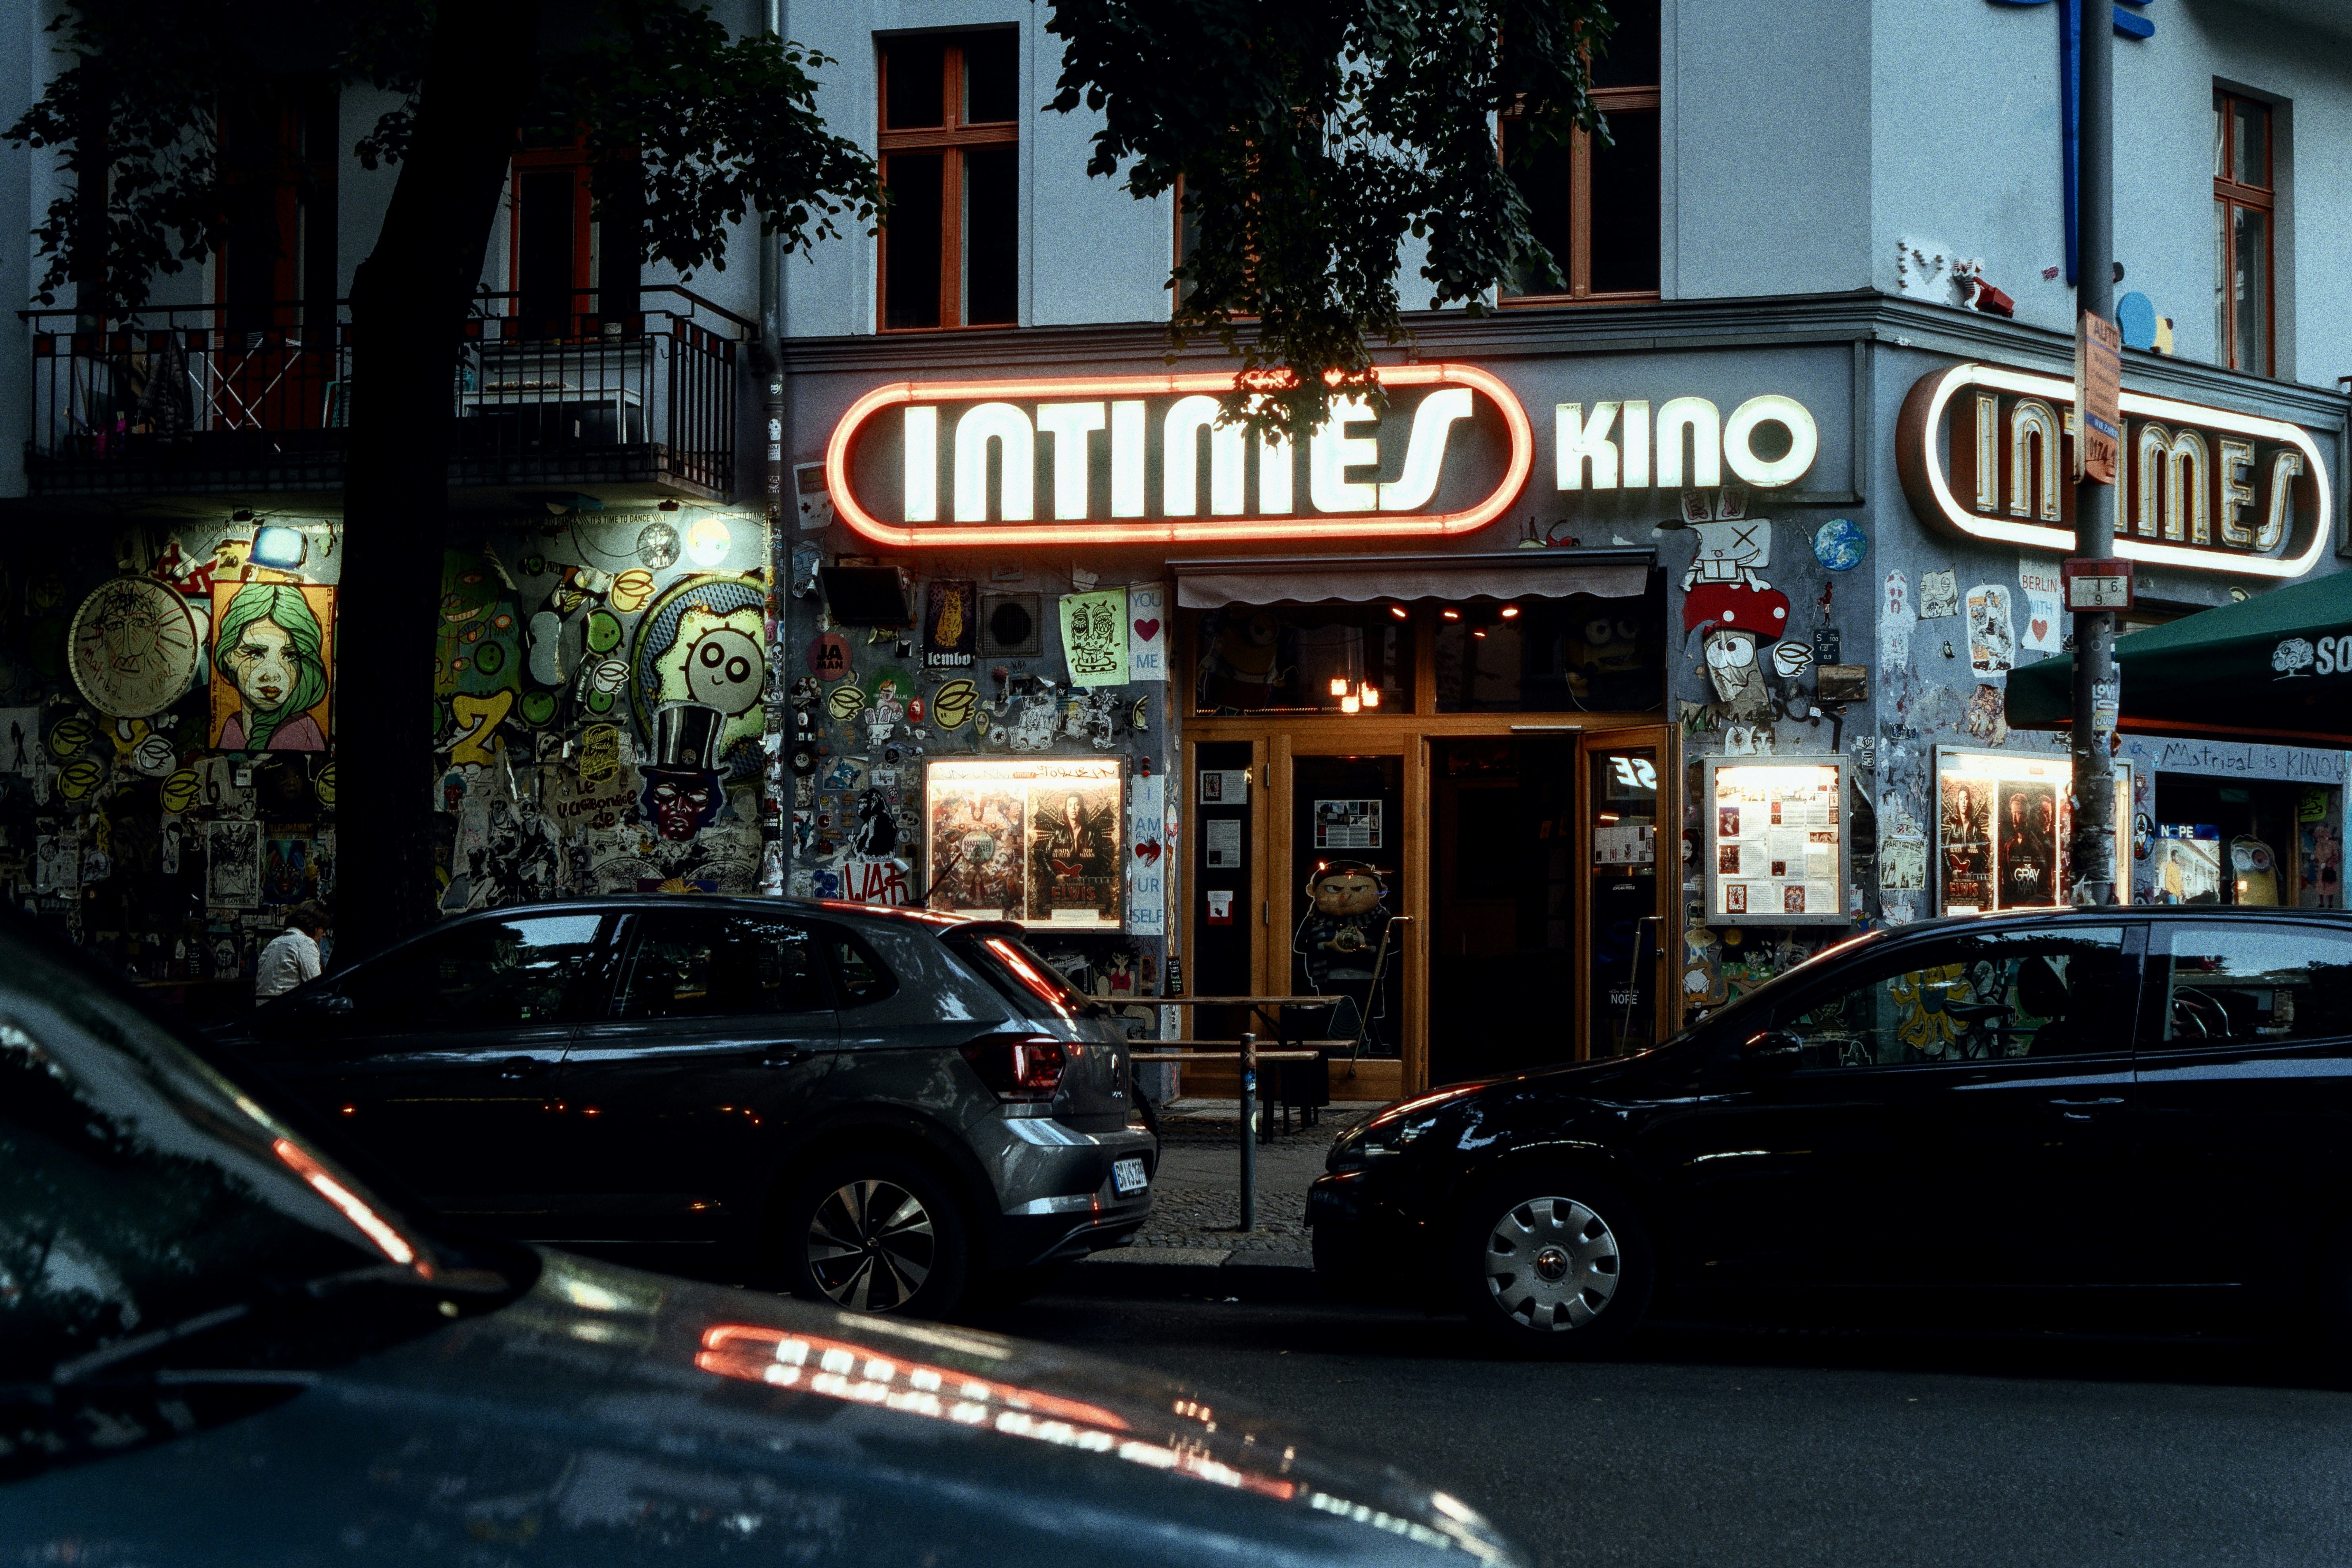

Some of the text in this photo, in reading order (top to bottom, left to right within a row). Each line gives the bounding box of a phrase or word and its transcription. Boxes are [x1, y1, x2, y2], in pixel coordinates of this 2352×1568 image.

[1556, 394, 1818, 491] KINO
[905, 387, 1472, 522] INTIMES
[1976, 392, 2304, 552] INIMES
[605, 515, 618, 524] TIME
[630, 514, 650, 523] DANCE
[2022, 574, 2058, 593] BERLIN
[1132, 592, 1162, 608] YOU
[817, 644, 843, 661] JA
[927, 652, 972, 667] lembo
[816, 661, 844, 670] MAN
[1136, 654, 1159, 669] ME
[1147, 787, 1151, 800] I
[1135, 817, 1162, 831] AM
[2014, 868, 2040, 882] GRAY
[1138, 878, 1160, 892] UR
[1949, 882, 1979, 897] ELVIS
[2017, 881, 2038, 895] MAN
[1051, 886, 1096, 901] ELVIS
[1132, 909, 1163, 923] SELF
